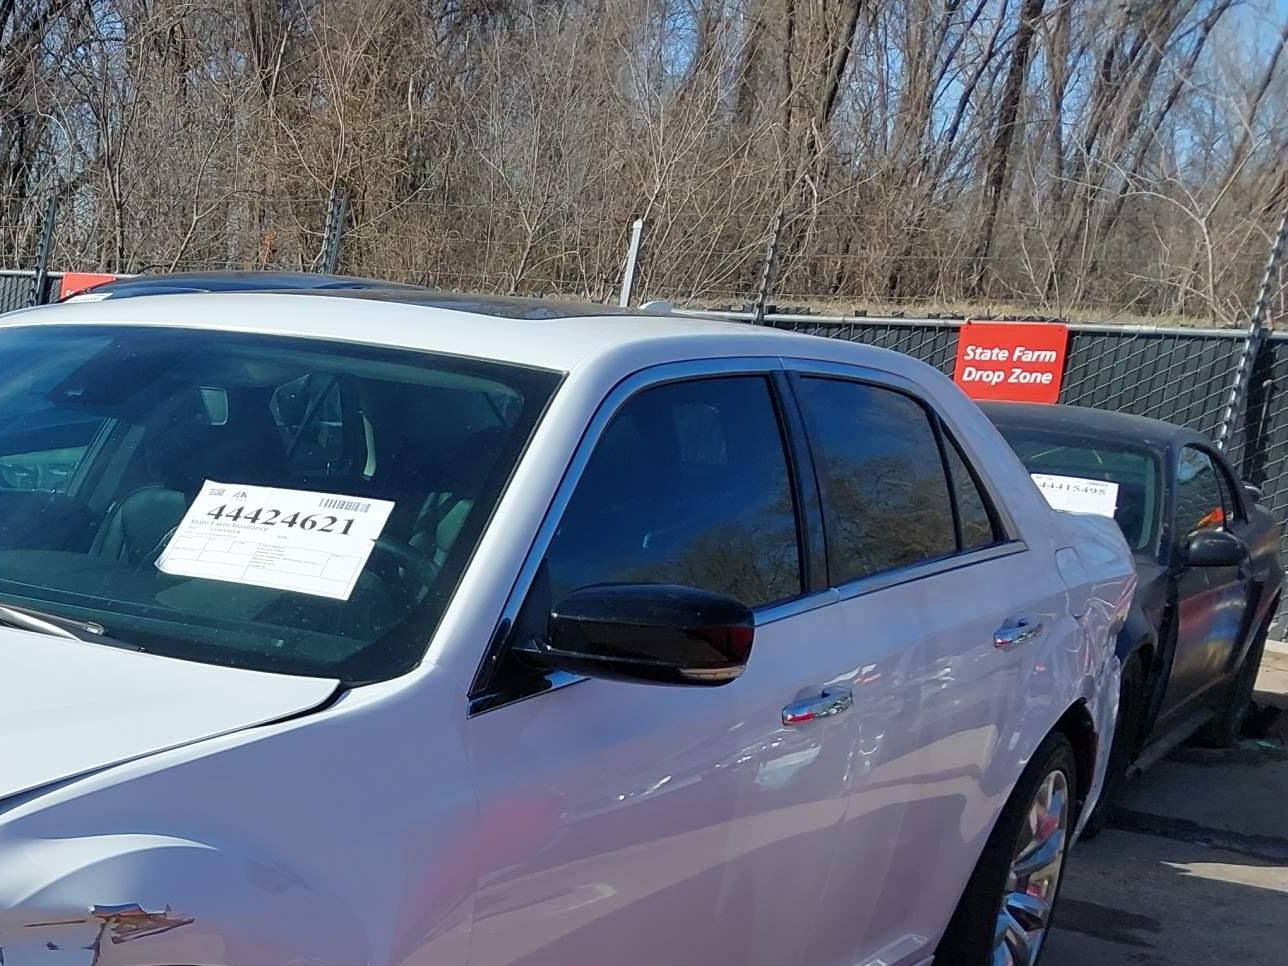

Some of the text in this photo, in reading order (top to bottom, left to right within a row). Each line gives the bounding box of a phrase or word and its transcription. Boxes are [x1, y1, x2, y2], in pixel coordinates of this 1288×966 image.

[963, 345, 1057, 363] State Farm
[961, 366, 1053, 386] Drop Zone
[207, 503, 355, 536] 44424621
